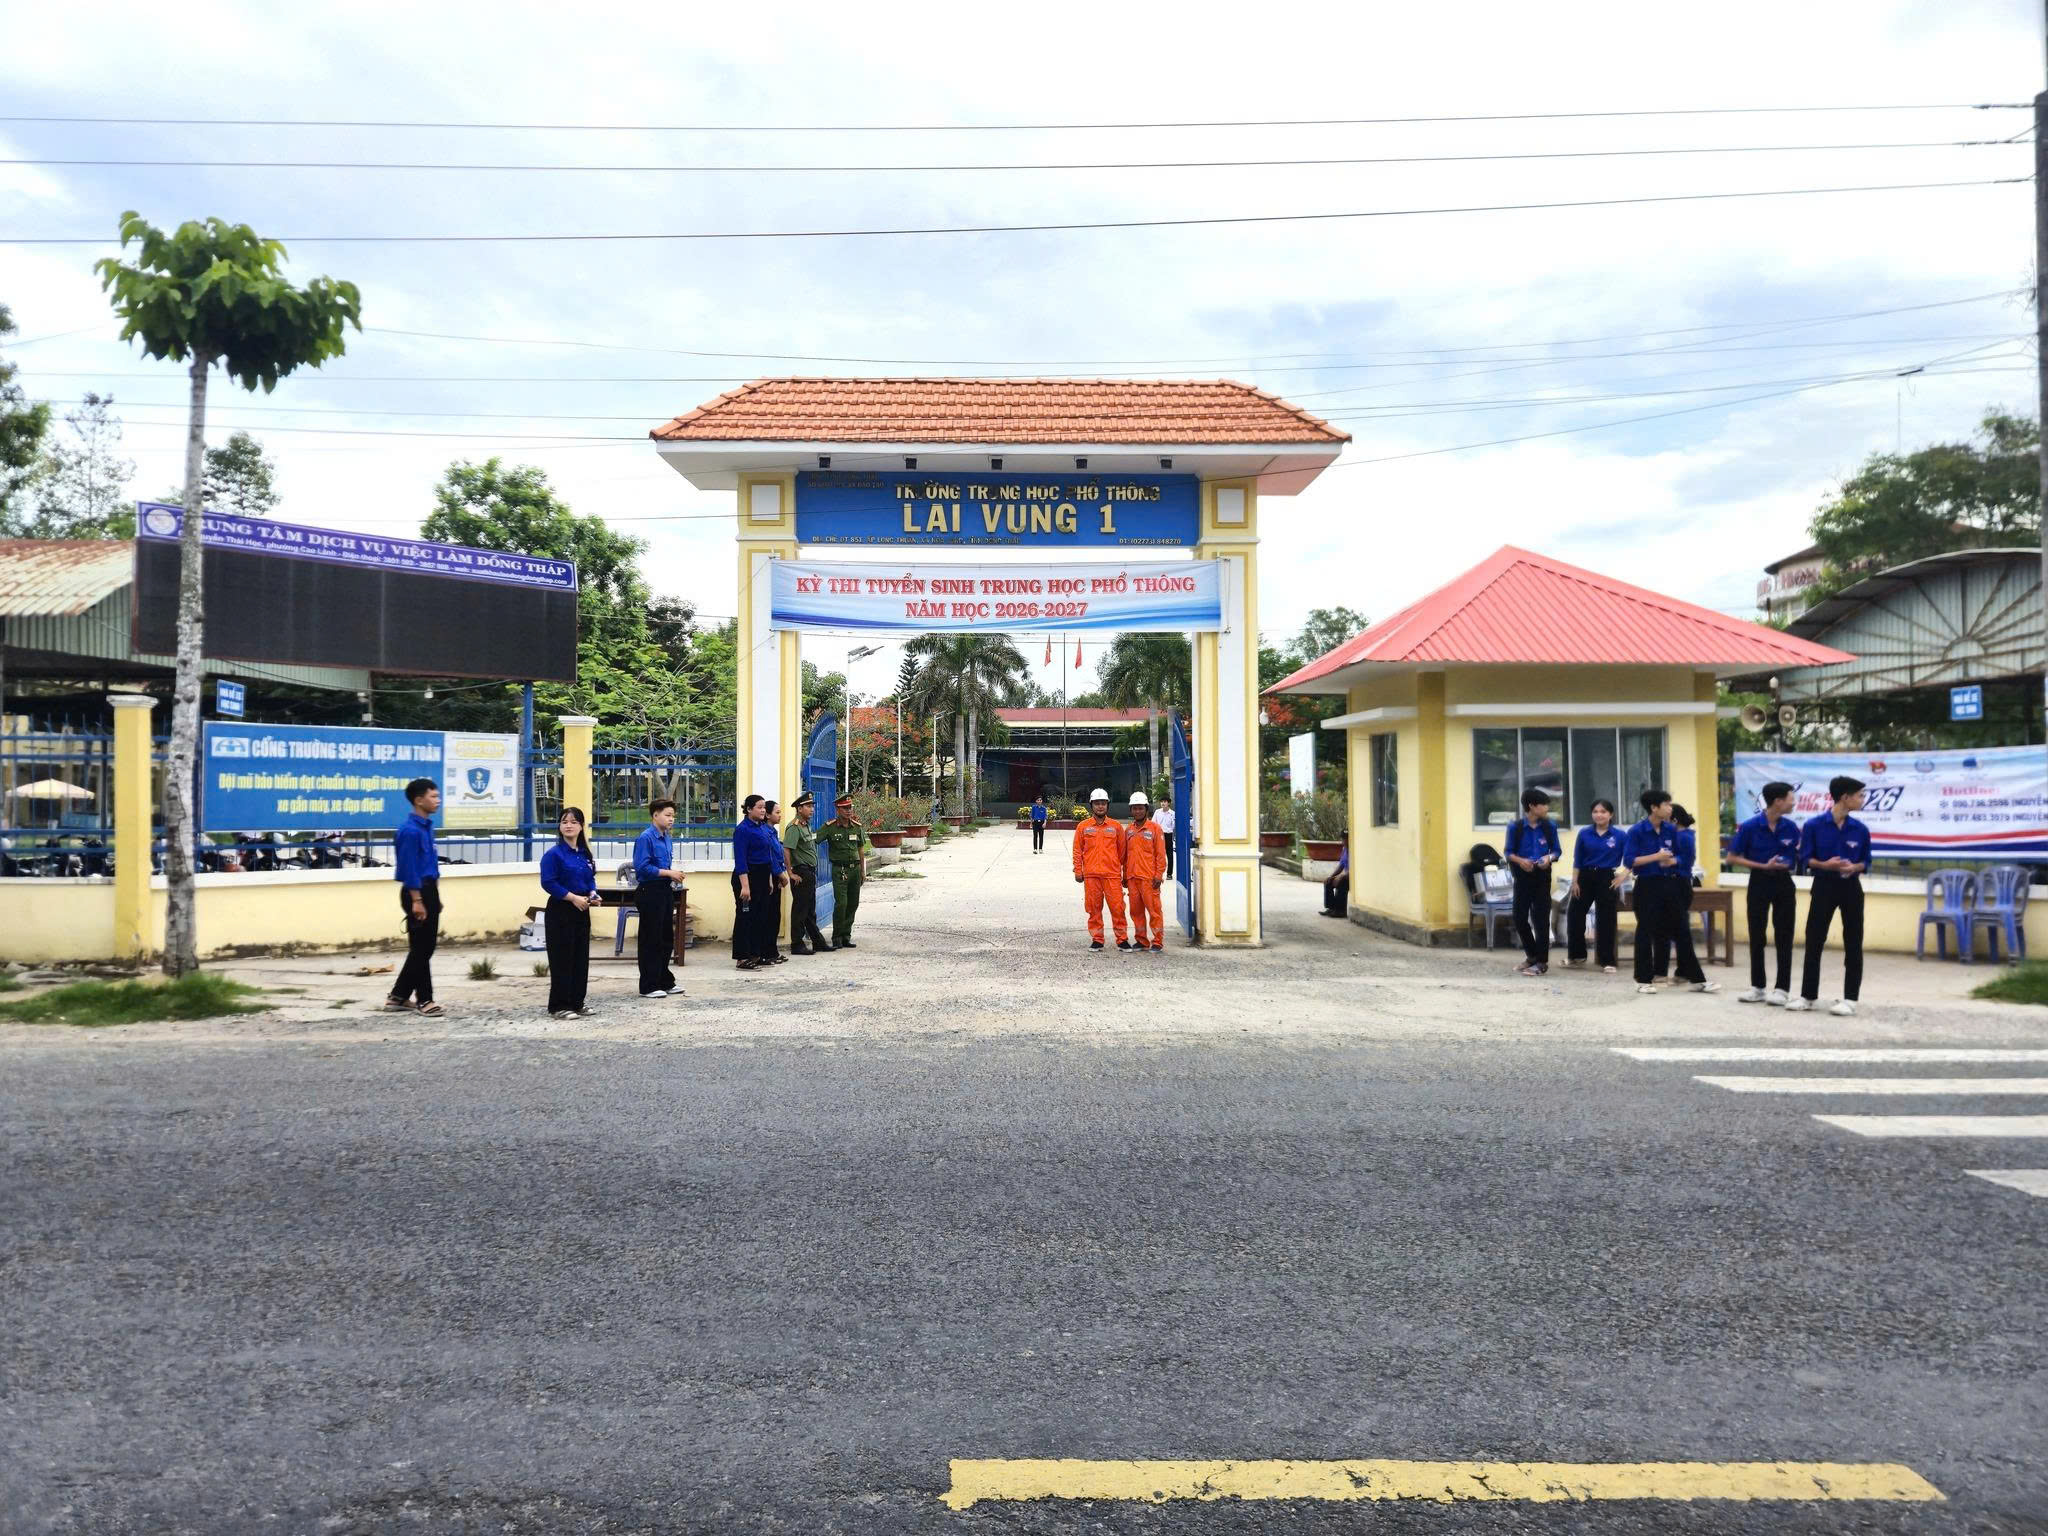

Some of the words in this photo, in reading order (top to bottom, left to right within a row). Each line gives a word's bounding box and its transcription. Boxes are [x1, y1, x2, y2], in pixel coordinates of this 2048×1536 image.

[967, 484, 1021, 500] TRNG
[1026, 485, 1060, 503] HỌC
[1066, 477, 1099, 500] HỔ
[1105, 481, 1161, 500] THÔNG
[903, 503, 961, 533] LAI
[981, 503, 1077, 533] VUNG
[1099, 503, 1117, 533] 1
[257, 525, 304, 543] TÂM
[309, 533, 358, 551] DỊCH
[360, 539, 388, 555] VỤ
[390, 543, 433, 561] VIỆC
[437, 549, 473, 565] LÀM
[477, 553, 522, 571] ĐỒNG
[525, 561, 567, 577] THÁP
[796, 573, 822, 593] KỲ
[828, 578, 860, 593] THI
[866, 572, 926, 594] TUYỂN
[931, 579, 975, 594] SINH
[980, 579, 1043, 595] TRUNG
[1047, 578, 1087, 598] HỌC
[1091, 571, 1128, 593] PHỔ
[1133, 574, 1197, 593] THÔNG
[905, 599, 947, 619] NĂM
[951, 602, 990, 623] HỌC
[995, 602, 1088, 619] 2026-2027
[252, 735, 287, 757] CỔNG
[288, 738, 338, 759] TRƯỜNG
[338, 742, 371, 763] SẠCH,
[396, 745, 413, 760] AN
[413, 743, 441, 761] TOÀN
[219, 772, 236, 792] Đội
[237, 773, 253, 789] mũ
[254, 771, 273, 789] bảo
[274, 771, 298, 789] hiểm
[299, 773, 315, 792] đạt
[316, 772, 344, 790] chuẩn
[345, 774, 359, 789] khi
[360, 774, 380, 792] ngồi
[277, 799, 290, 812] xe
[330, 800, 343, 813] xe
[343, 799, 359, 815] đạp
